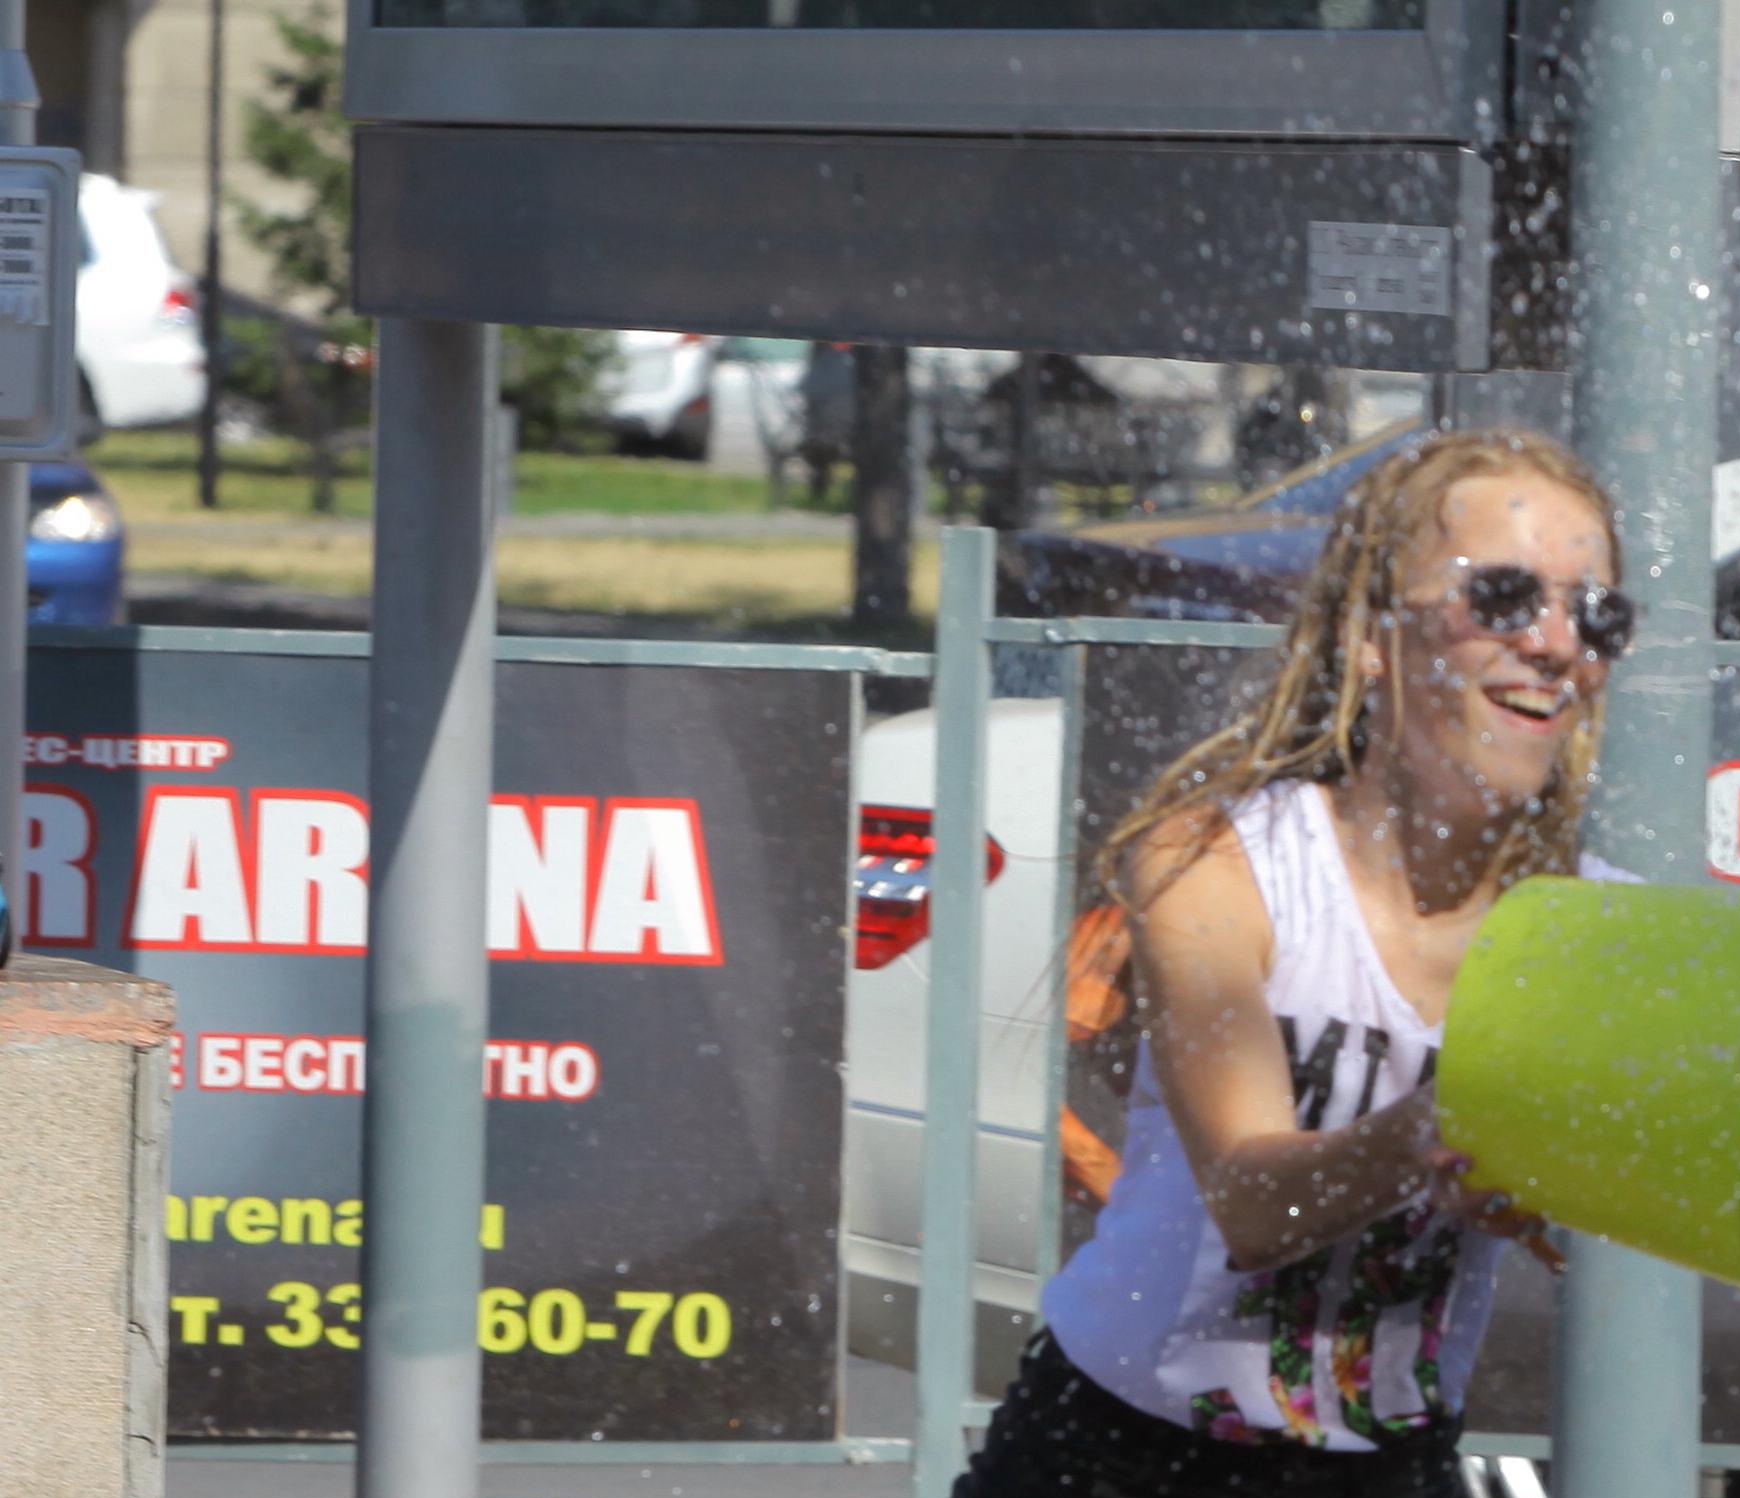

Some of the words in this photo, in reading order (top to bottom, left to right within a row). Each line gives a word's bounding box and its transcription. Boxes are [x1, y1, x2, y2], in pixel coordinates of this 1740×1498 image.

[122, 785, 723, 965] ARNA
[198, 1034, 600, 1102] БЕСПТНО
[265, 1280, 734, 1360] 3360-70
